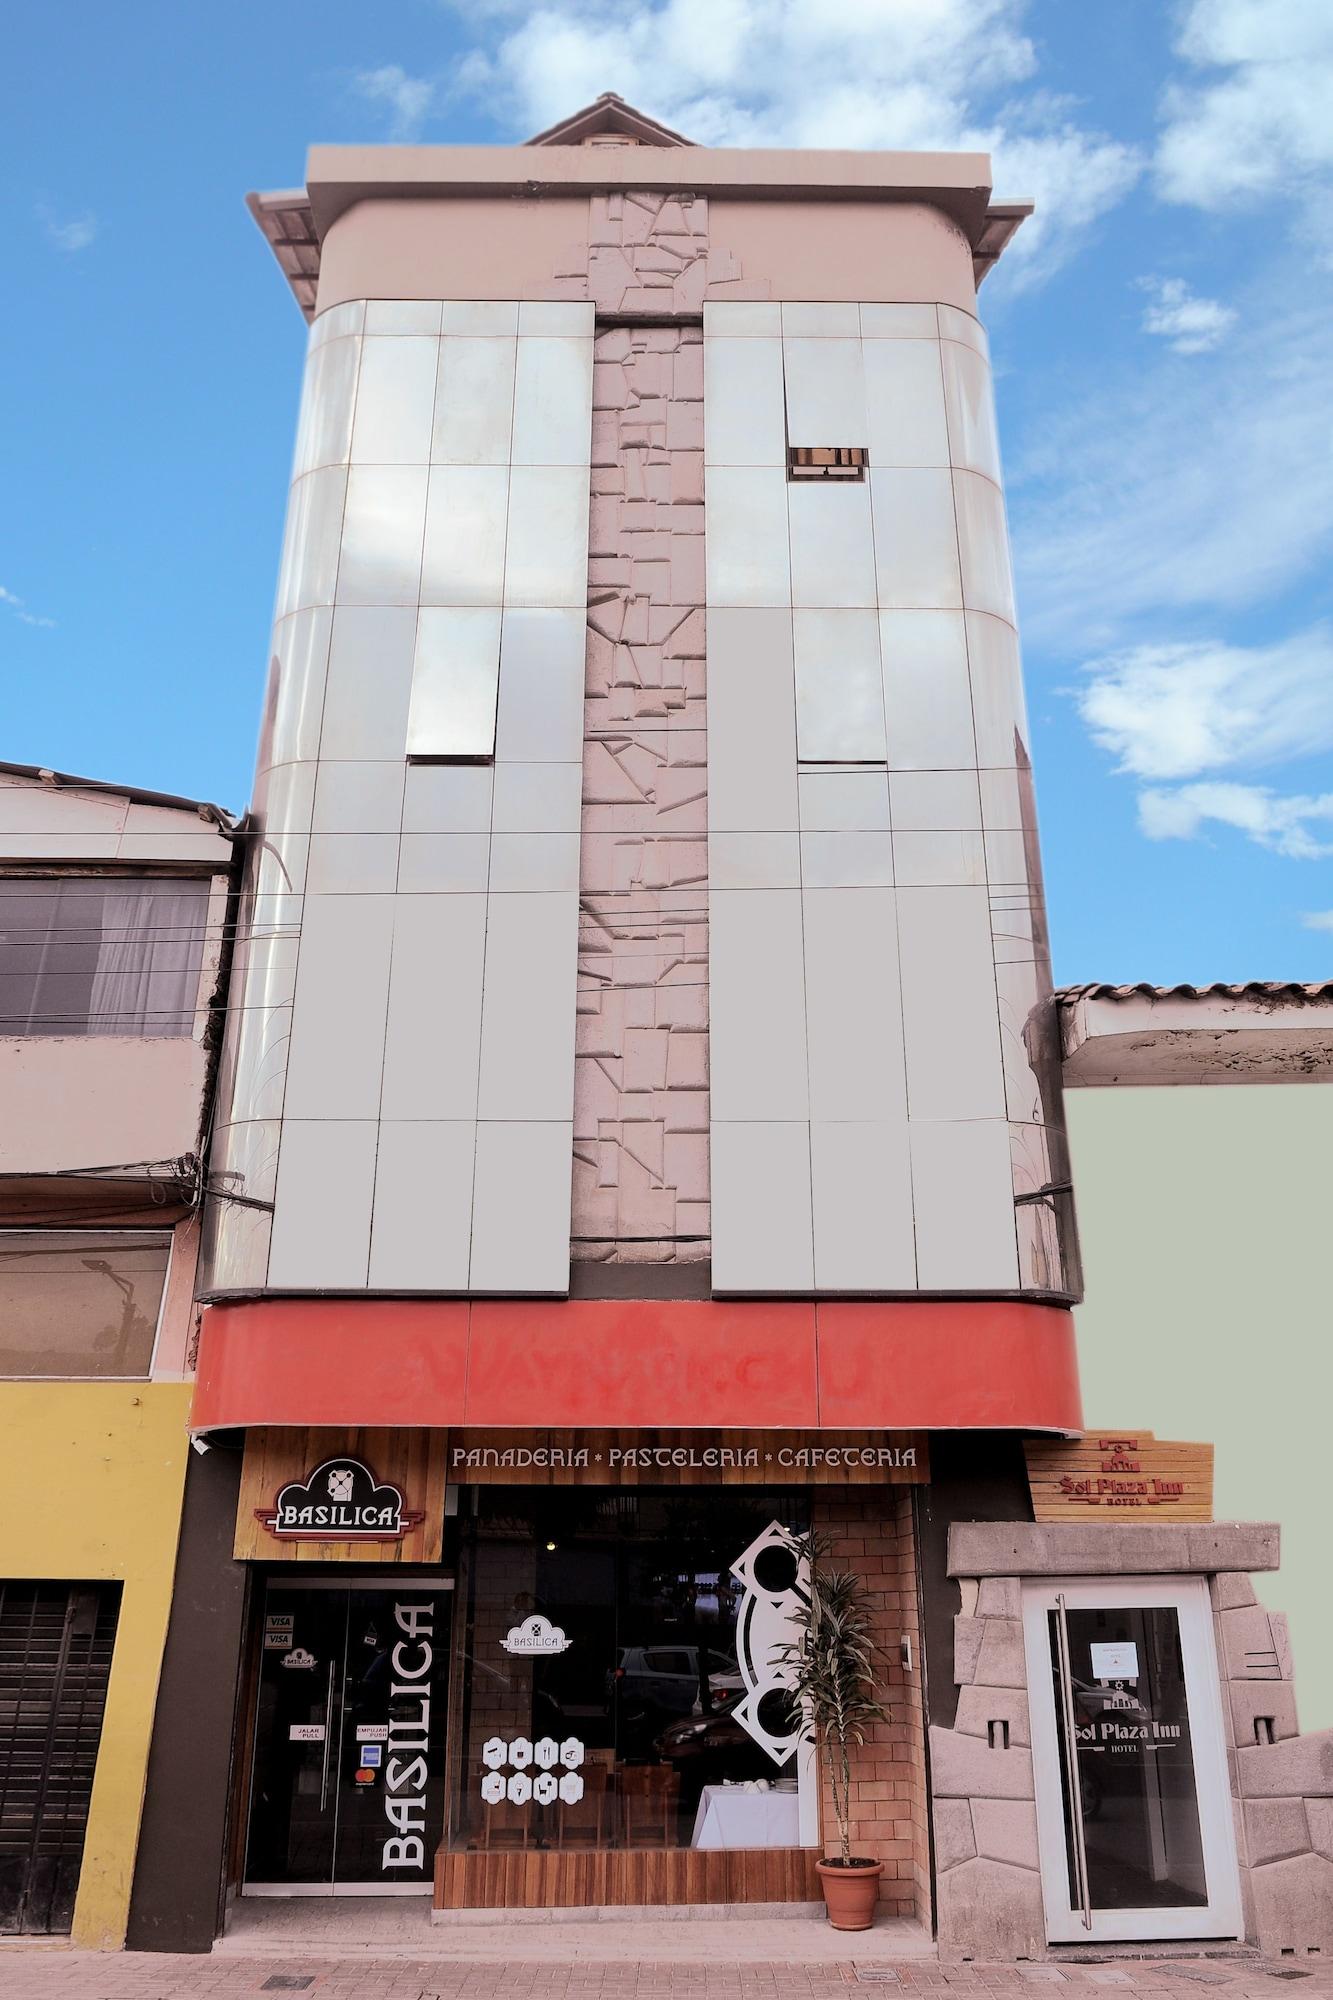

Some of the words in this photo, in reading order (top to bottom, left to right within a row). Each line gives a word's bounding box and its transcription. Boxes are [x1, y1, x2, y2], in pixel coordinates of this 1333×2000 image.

[452, 1448, 590, 1467] PANADERIA
[608, 1448, 759, 1467] PASTELERIA
[777, 1448, 917, 1467] CAFETERIA
[1060, 1476, 1090, 1494] Sol
[1097, 1478, 1148, 1495] Plaza
[1152, 1478, 1184, 1495] Inn
[1106, 1497, 1142, 1506] HOTEL
[283, 1505, 394, 1526] BASILICA
[271, 1617, 291, 1626] VISA
[269, 1635, 289, 1643] VISA
[514, 1637, 558, 1647] BASILICA
[382, 1601, 434, 1871] BASILICA
[1101, 1722, 1149, 1740] Plaza
[1150, 1721, 1181, 1738] Inn
[1111, 1743, 1140, 1753] HOTEL
